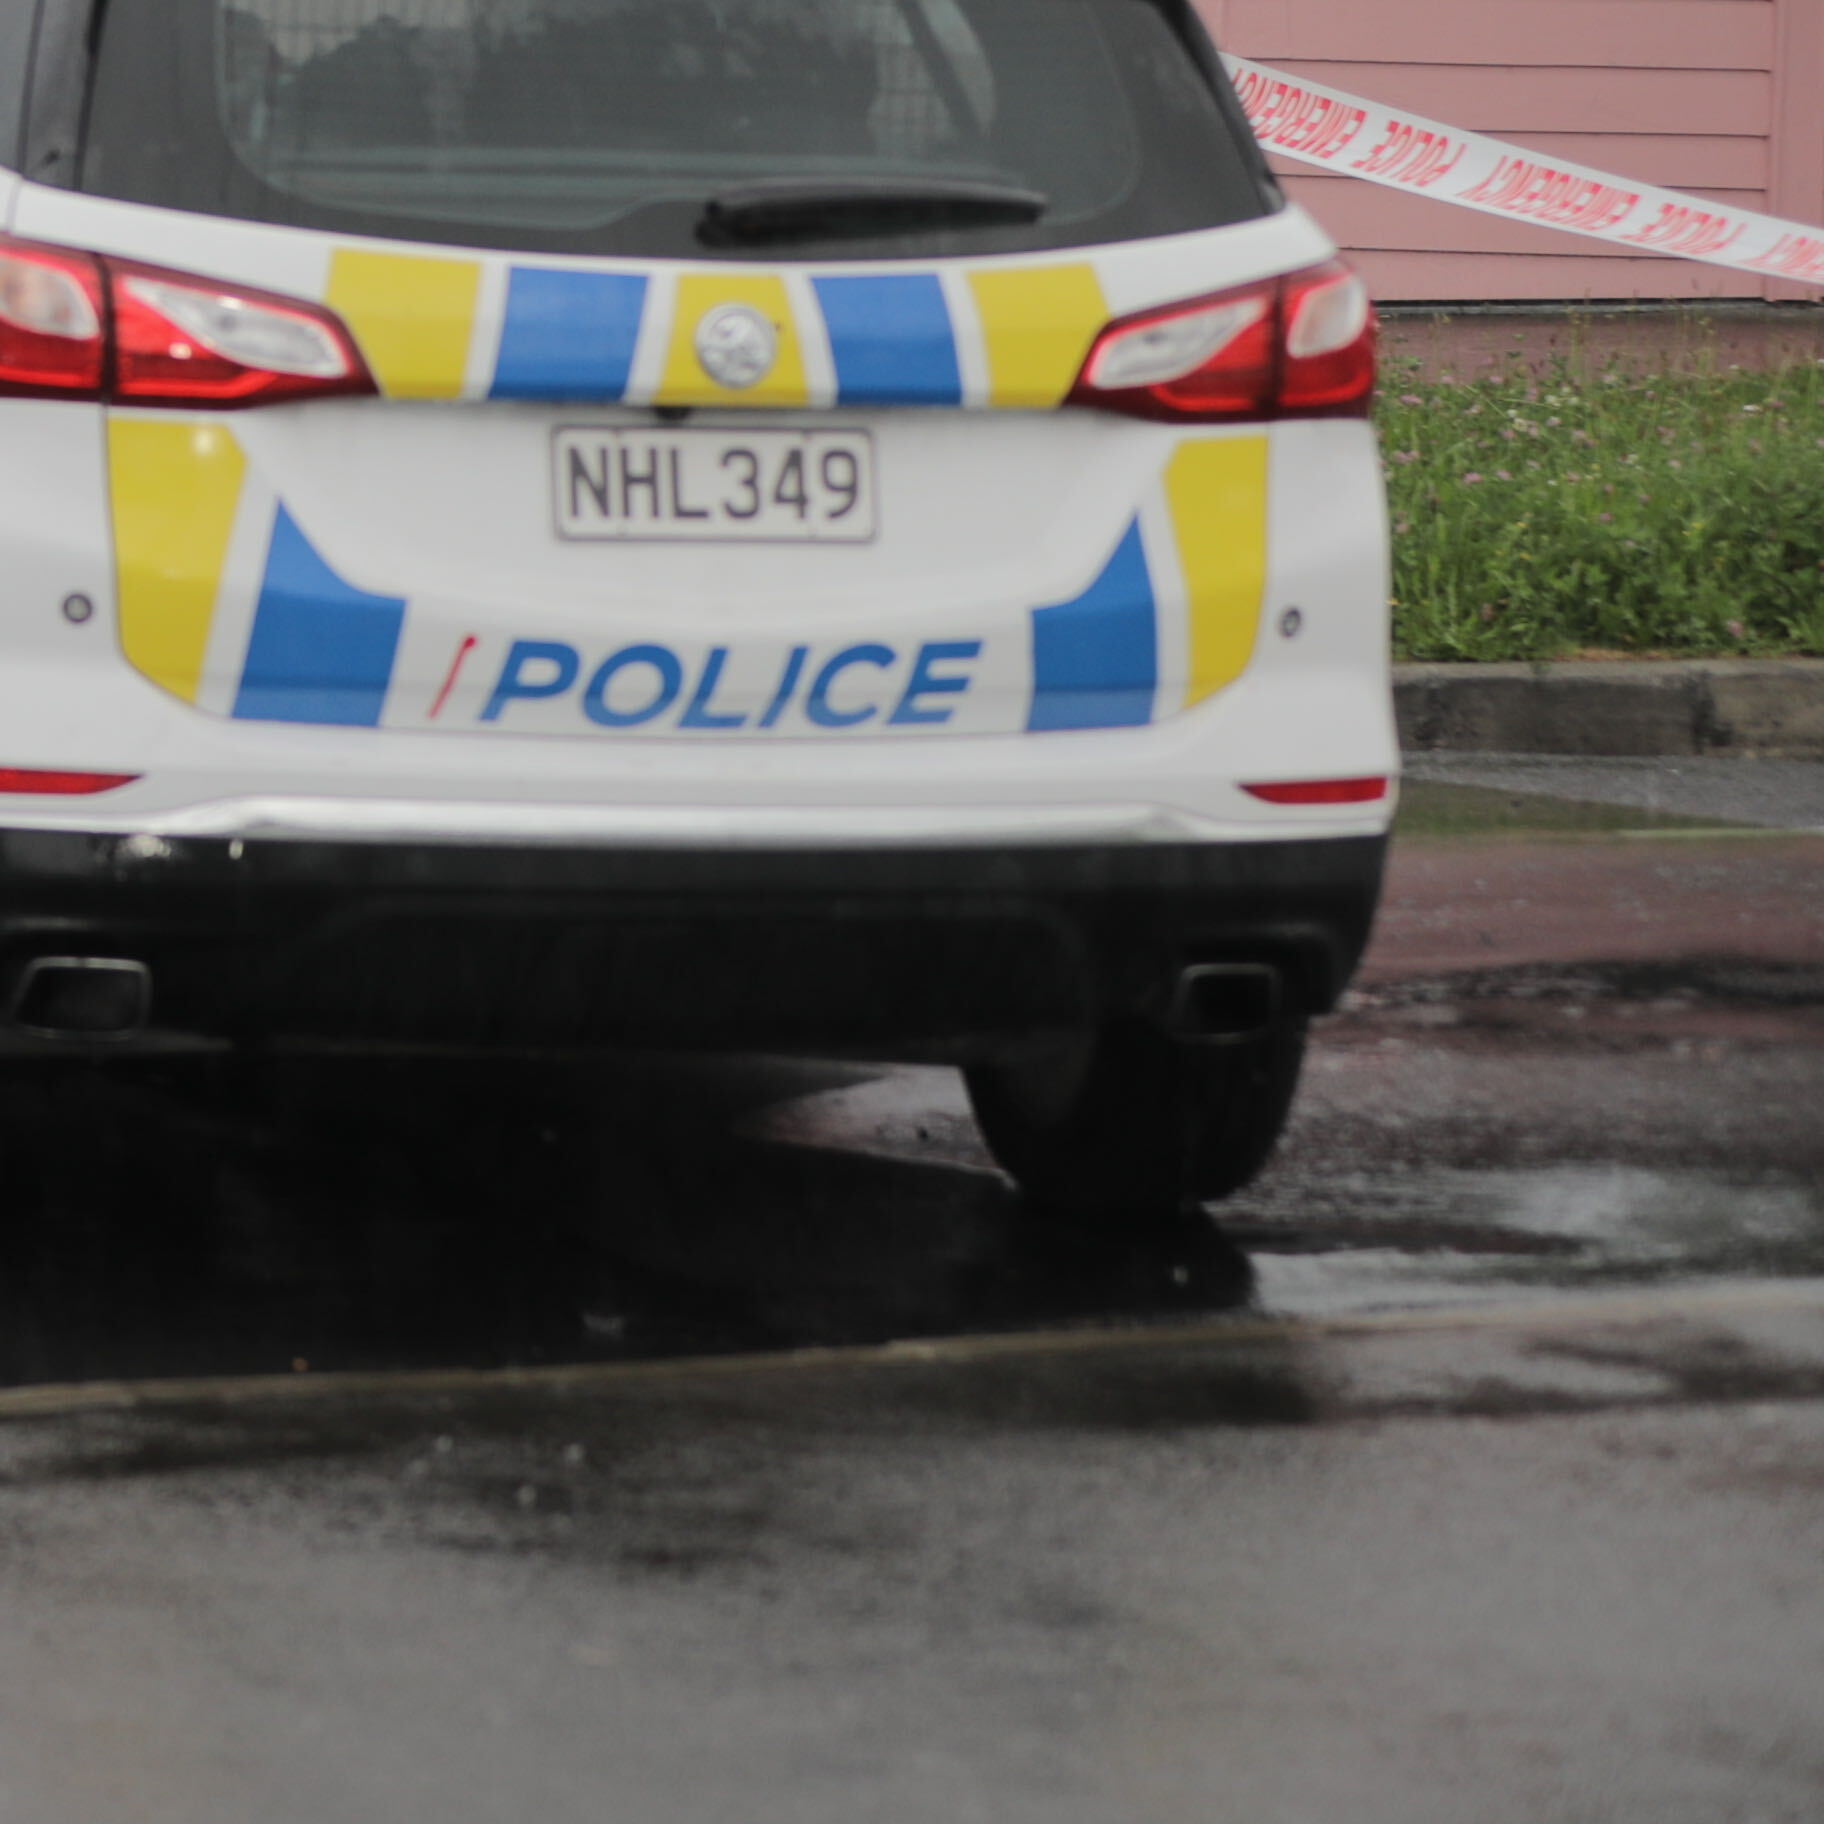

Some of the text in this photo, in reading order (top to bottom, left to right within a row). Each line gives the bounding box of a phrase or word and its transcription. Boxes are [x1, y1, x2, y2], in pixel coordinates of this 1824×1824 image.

[1351, 119, 1467, 188] POLICE
[567, 446, 860, 522] NHL349
[479, 637, 987, 732] POLICE
